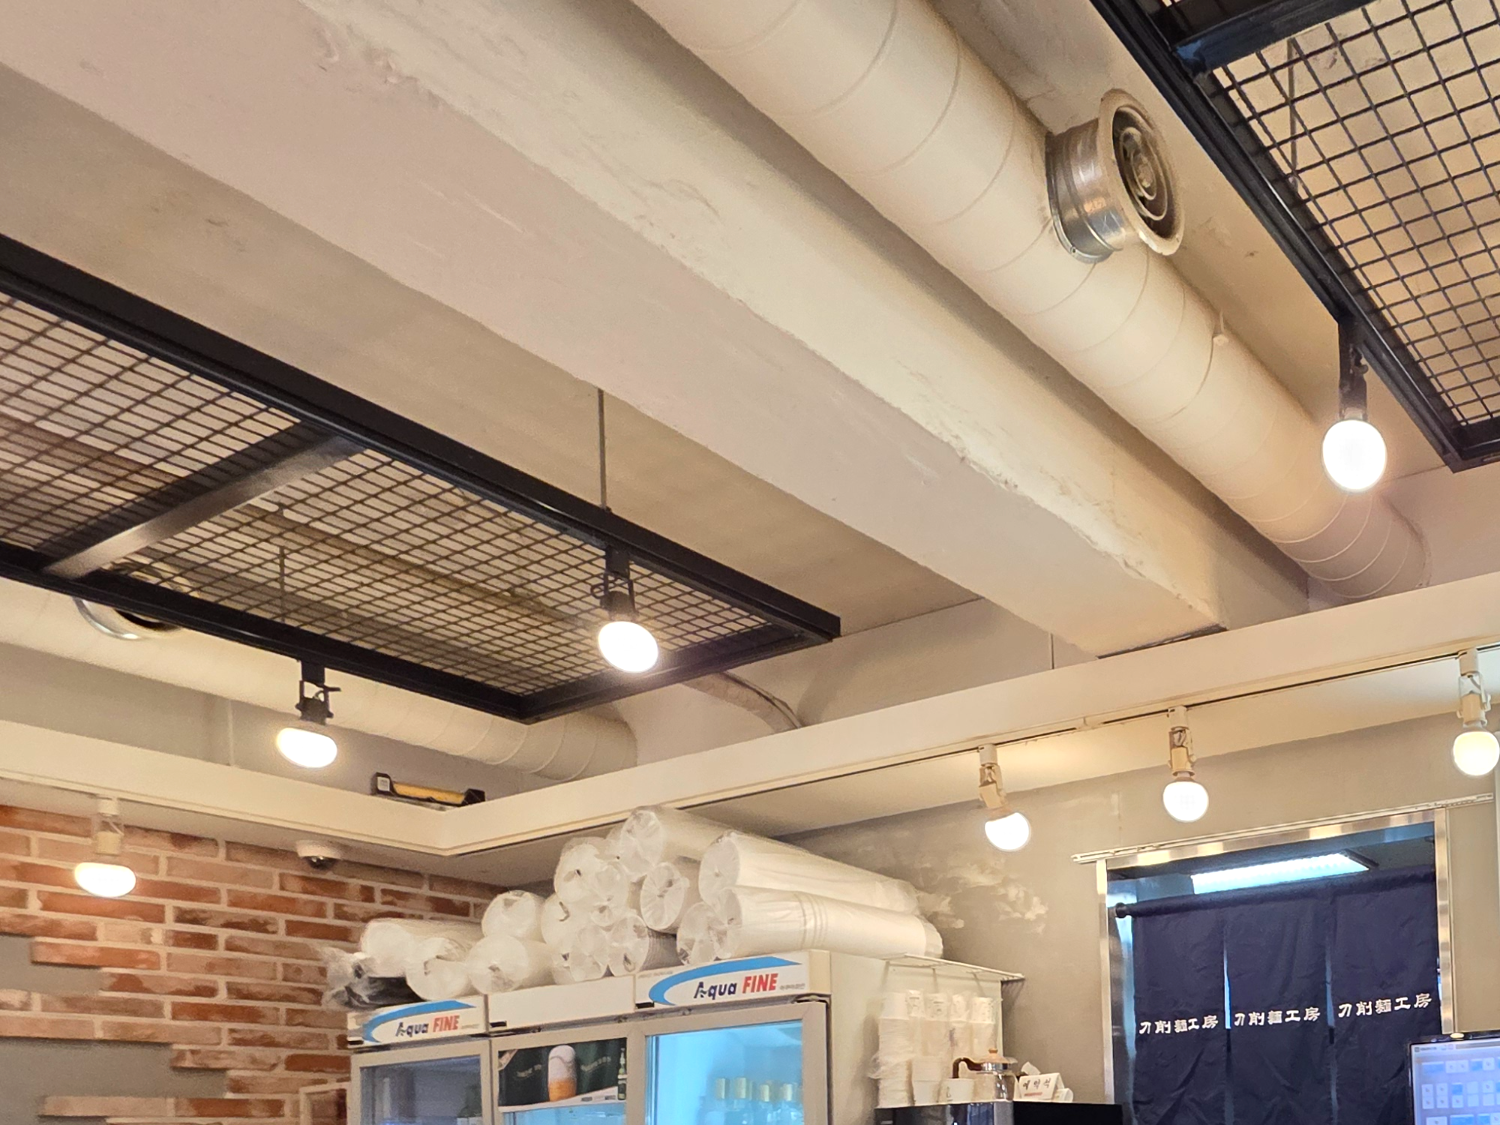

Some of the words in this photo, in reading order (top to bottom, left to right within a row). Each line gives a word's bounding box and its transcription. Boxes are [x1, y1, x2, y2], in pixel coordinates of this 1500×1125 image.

[693, 981, 738, 1000] Aqua
[742, 973, 779, 994] FINE
[1233, 1006, 1321, 1027] 刀削麵工房
[1337, 992, 1434, 1018] 刀削麵工房
[395, 1021, 429, 1038] Aqua
[433, 1014, 460, 1033] FINE
[1138, 1014, 1219, 1035] 刀削麵工房
